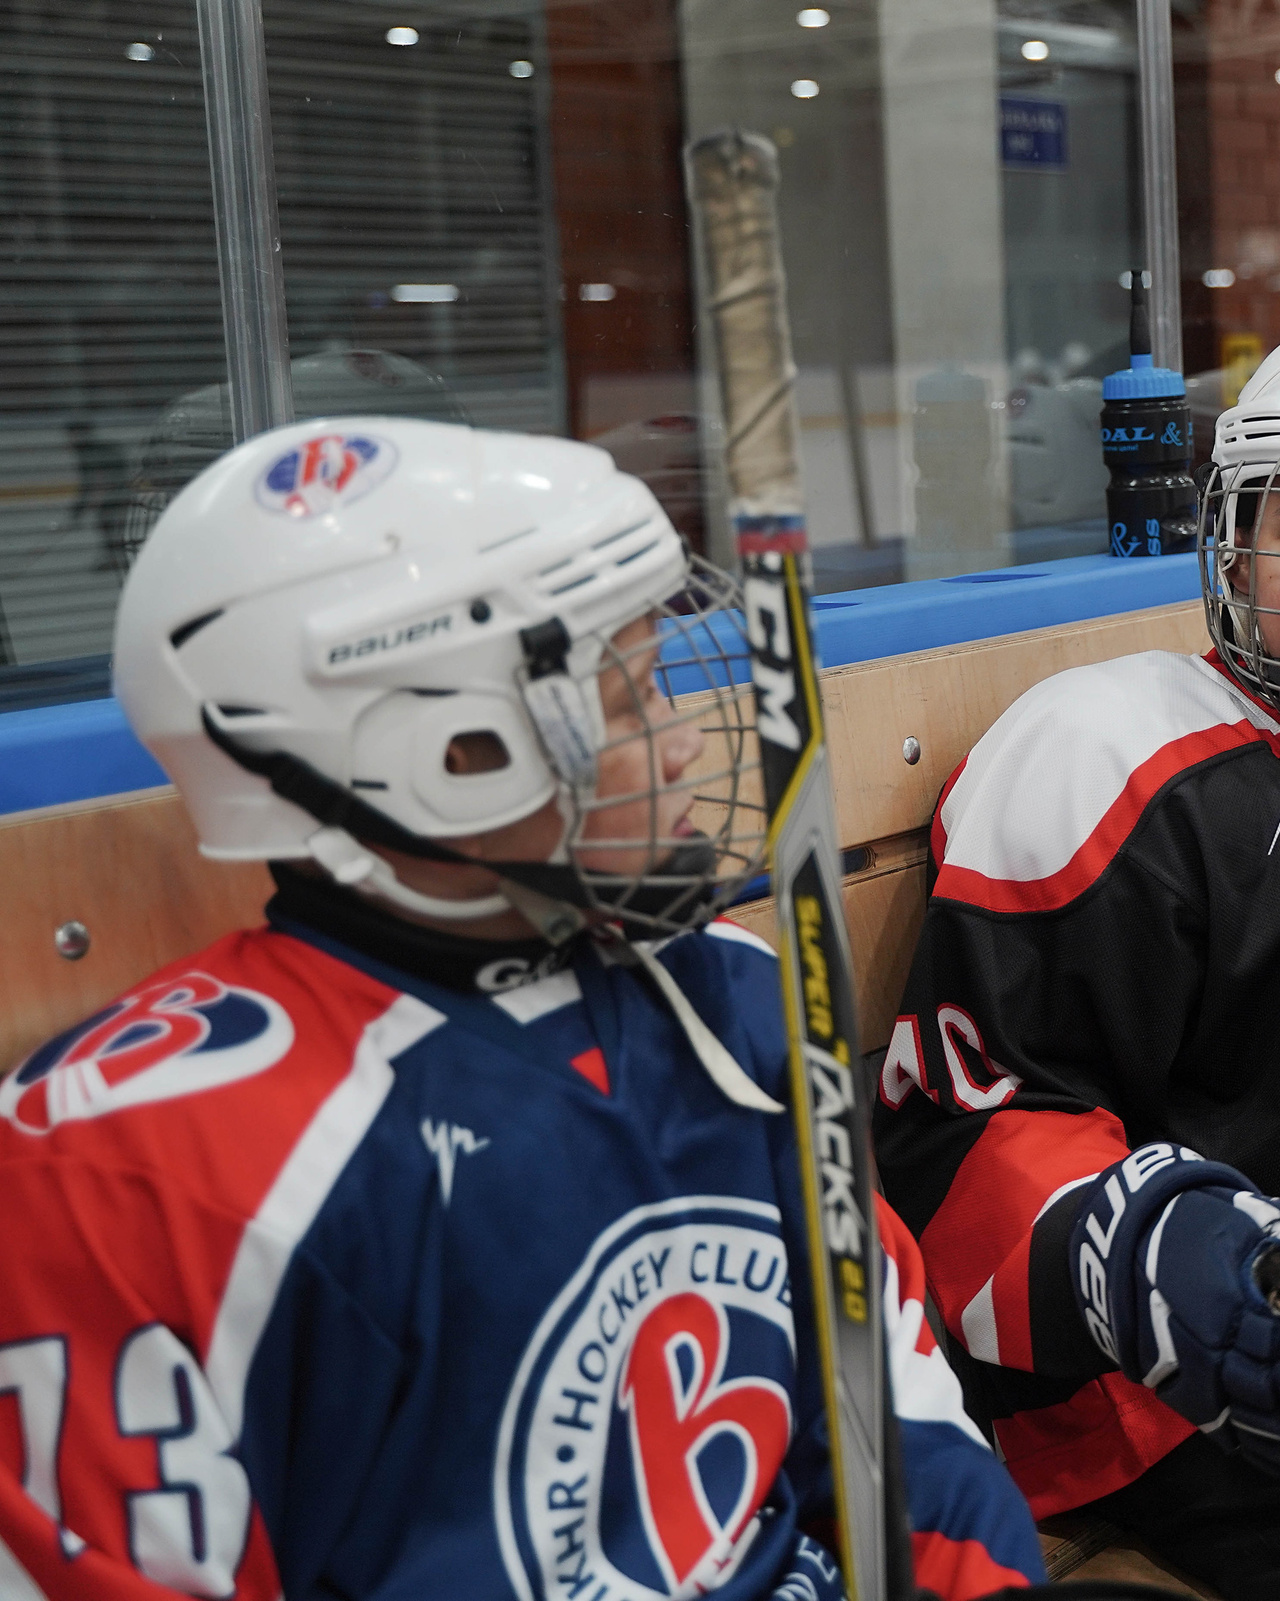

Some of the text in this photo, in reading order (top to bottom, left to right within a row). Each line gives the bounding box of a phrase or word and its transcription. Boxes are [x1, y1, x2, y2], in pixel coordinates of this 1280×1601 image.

[1160, 421, 1184, 446] &
[328, 614, 453, 665] BAUER
[743, 552, 801, 751] CM
[801, 1040, 868, 1258] TACKS
[879, 1002, 1024, 1112] 40
[552, 1246, 672, 1432] HOCKEY
[0, 1322, 253, 1600] 73
